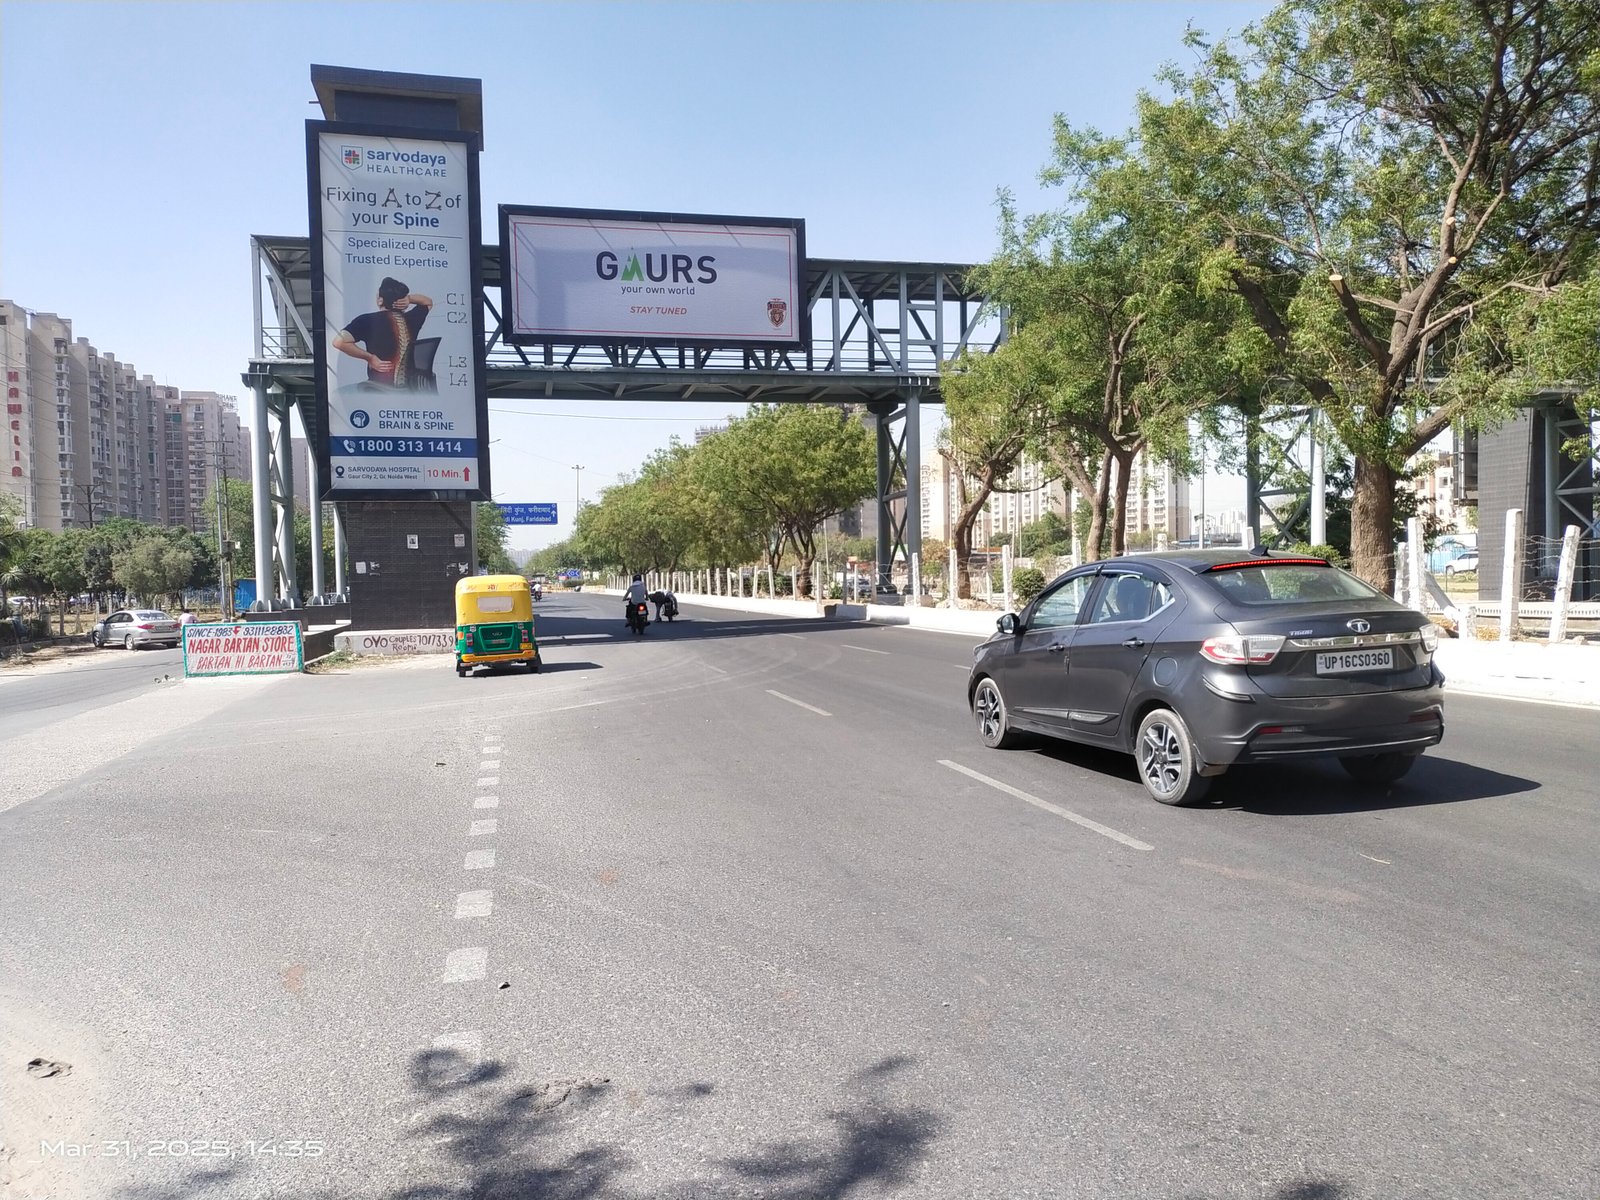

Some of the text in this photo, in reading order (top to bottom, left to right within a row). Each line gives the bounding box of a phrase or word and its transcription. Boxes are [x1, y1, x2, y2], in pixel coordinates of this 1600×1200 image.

[366, 149, 447, 167] sarvodaya
[366, 164, 447, 178] HEALTHCARE
[326, 186, 462, 211] Fixing A to Z of
[352, 212, 440, 229] your Spine
[347, 236, 448, 253] Specialized Care,
[345, 253, 449, 269] Trusted Expertise
[595, 248, 718, 284] GAURS
[621, 285, 644, 295] your
[667, 286, 695, 296] world
[447, 311, 468, 324] C2
[629, 305, 688, 315] STAY TUNED
[448, 355, 467, 368] L3
[449, 372, 468, 387] L4
[378, 409, 443, 420] CENTRE FOR
[378, 420, 455, 431] BRAIN & SPINE
[358, 439, 462, 453] 1800 313 1414
[427, 469, 462, 479] 10 Min.
[188, 636, 294, 654] NAGAR BARTAN STORE
[197, 655, 232, 670] BARTAN
[235, 655, 245, 669] HI
[247, 654, 283, 668] BARTAN
[1324, 652, 1390, 670] UP16CS0360
